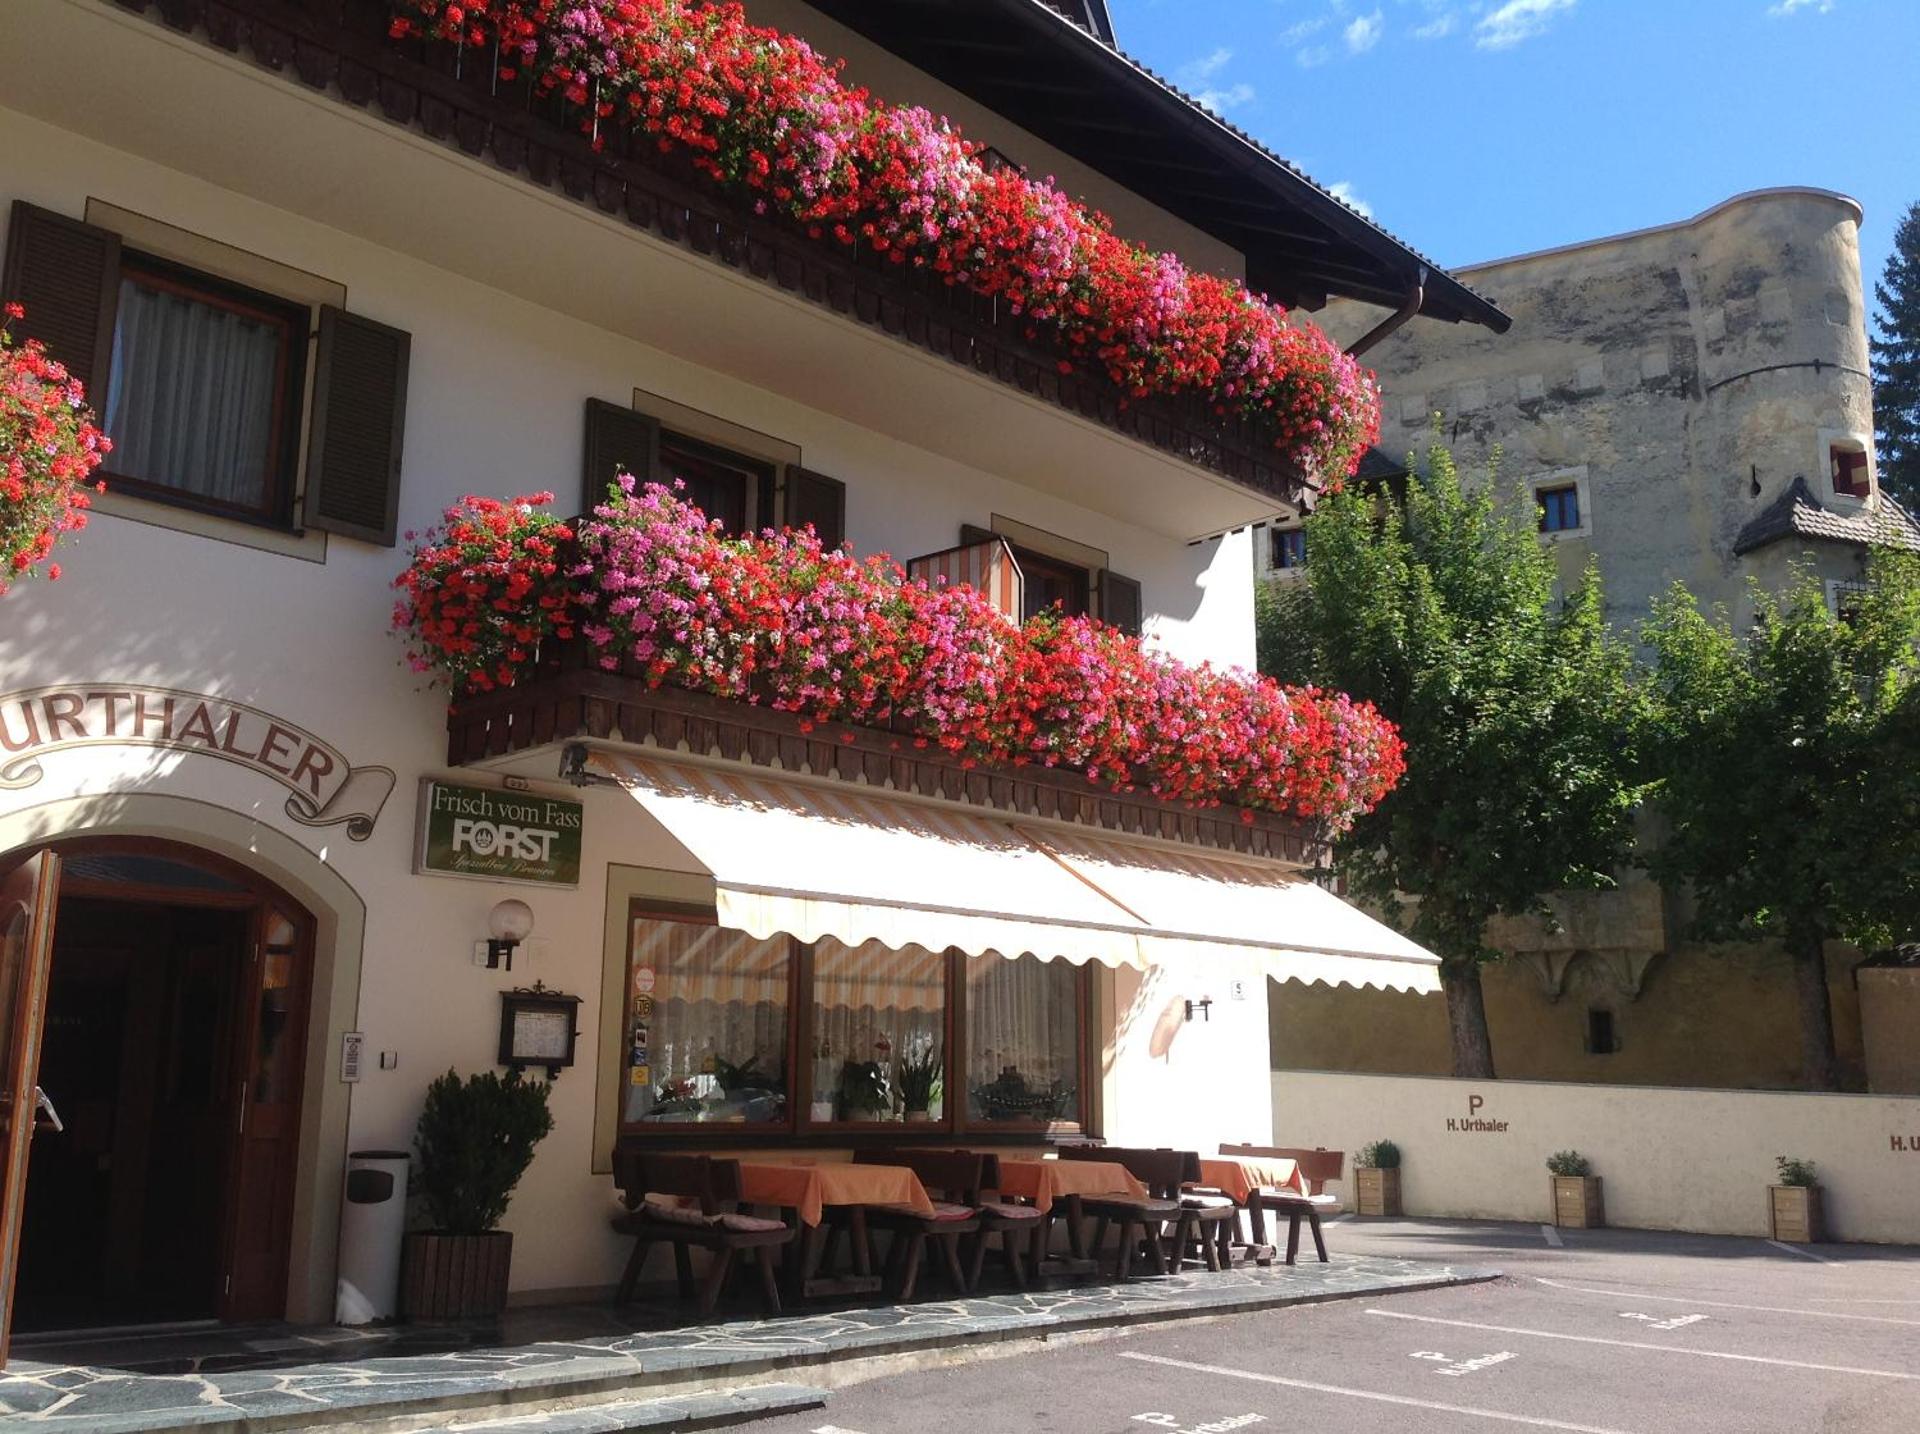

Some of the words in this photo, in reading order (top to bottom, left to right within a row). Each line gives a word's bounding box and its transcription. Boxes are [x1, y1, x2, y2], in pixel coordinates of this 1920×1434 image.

[0, 692, 335, 797] URTHALER
[434, 786, 493, 817] Frisch
[499, 802, 539, 823] vom
[545, 802, 580, 828] Fass
[452, 818, 559, 862] FORST
[1469, 1095, 1484, 1115] P
